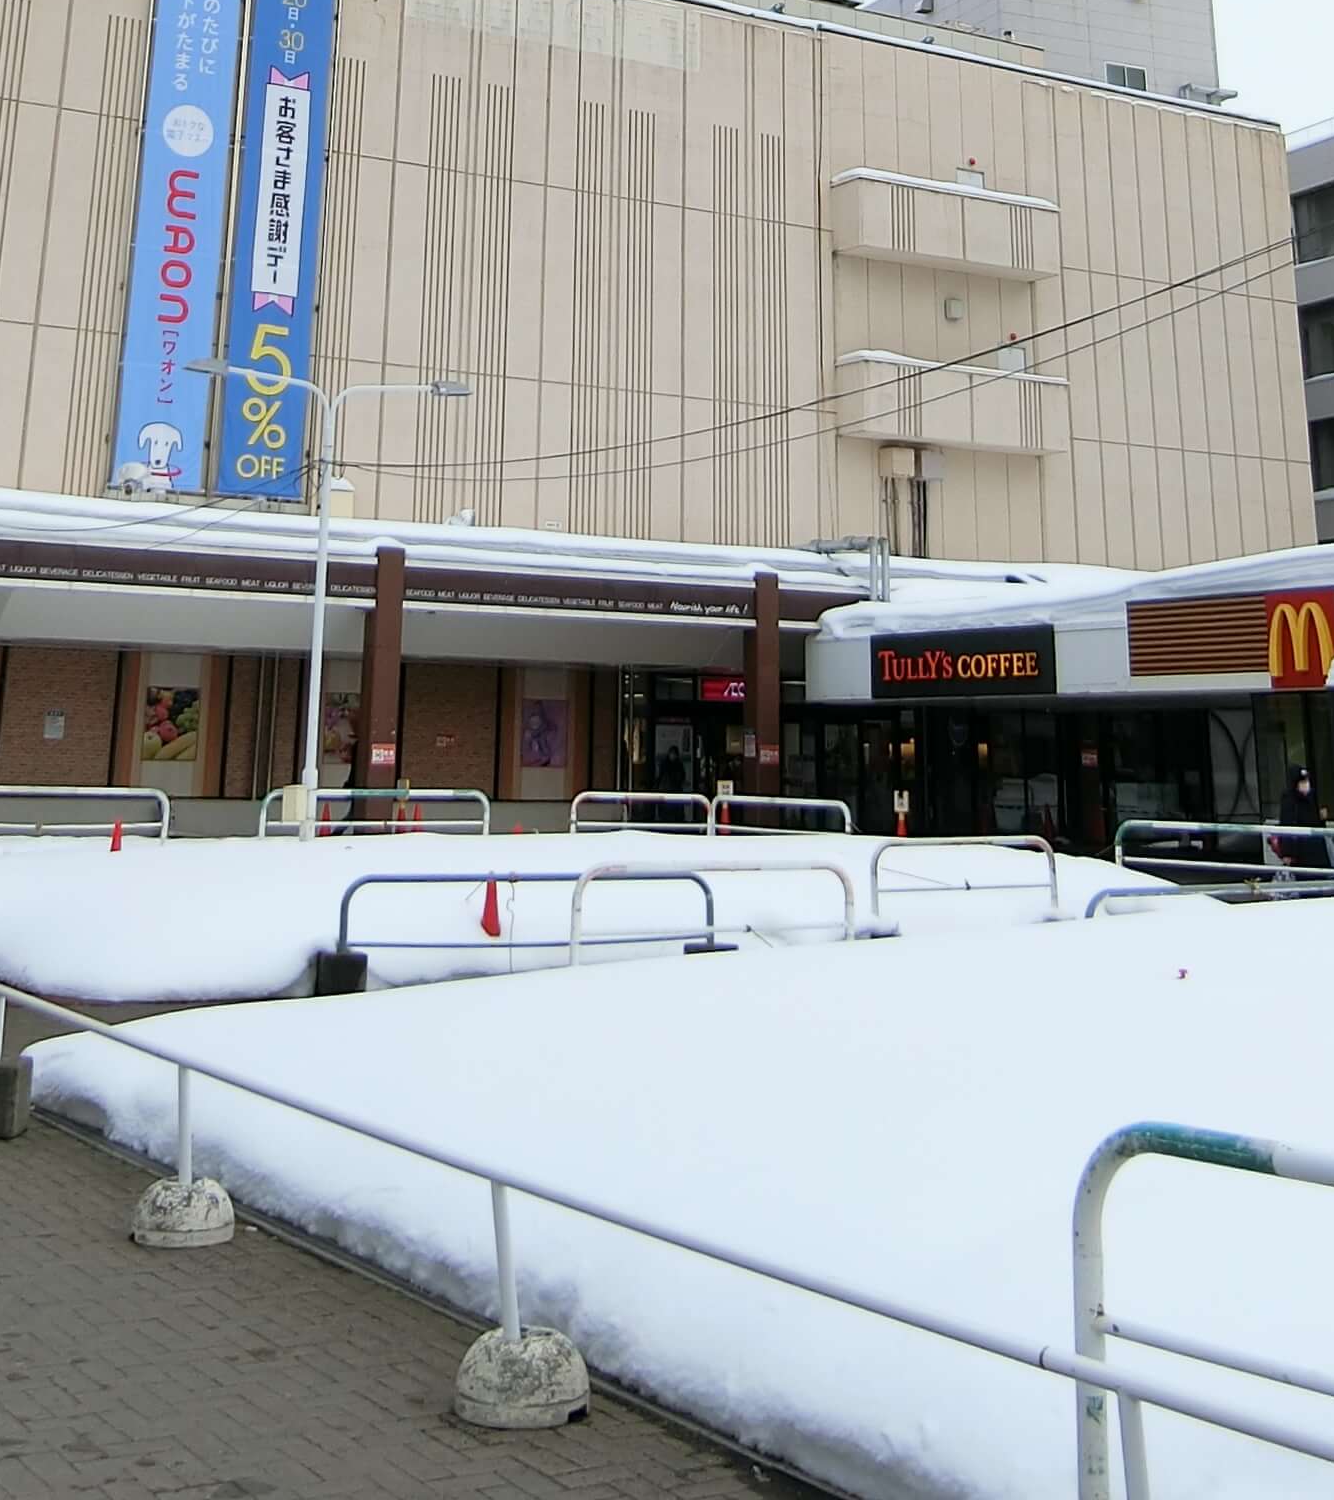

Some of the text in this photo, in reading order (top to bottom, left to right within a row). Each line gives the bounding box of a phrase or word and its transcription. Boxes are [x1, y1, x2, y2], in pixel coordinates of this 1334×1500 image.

[267, 96, 298, 285] お客さま感謝デー
[236, 454, 286, 480] OFF
[9, 565, 37, 574] LIQUOR
[40, 567, 78, 577] BEVERAGE
[82, 569, 134, 580] DELICATESSEN
[138, 572, 178, 583] VEGETABLE
[180, 575, 201, 584] FRUIT
[205, 577, 238, 587] SEAFOOD
[241, 579, 261, 588] MEAT
[264, 580, 288, 589] LIQUOR
[438, 590, 455, 599] MEAT
[957, 652, 1039, 678] COFFEE
